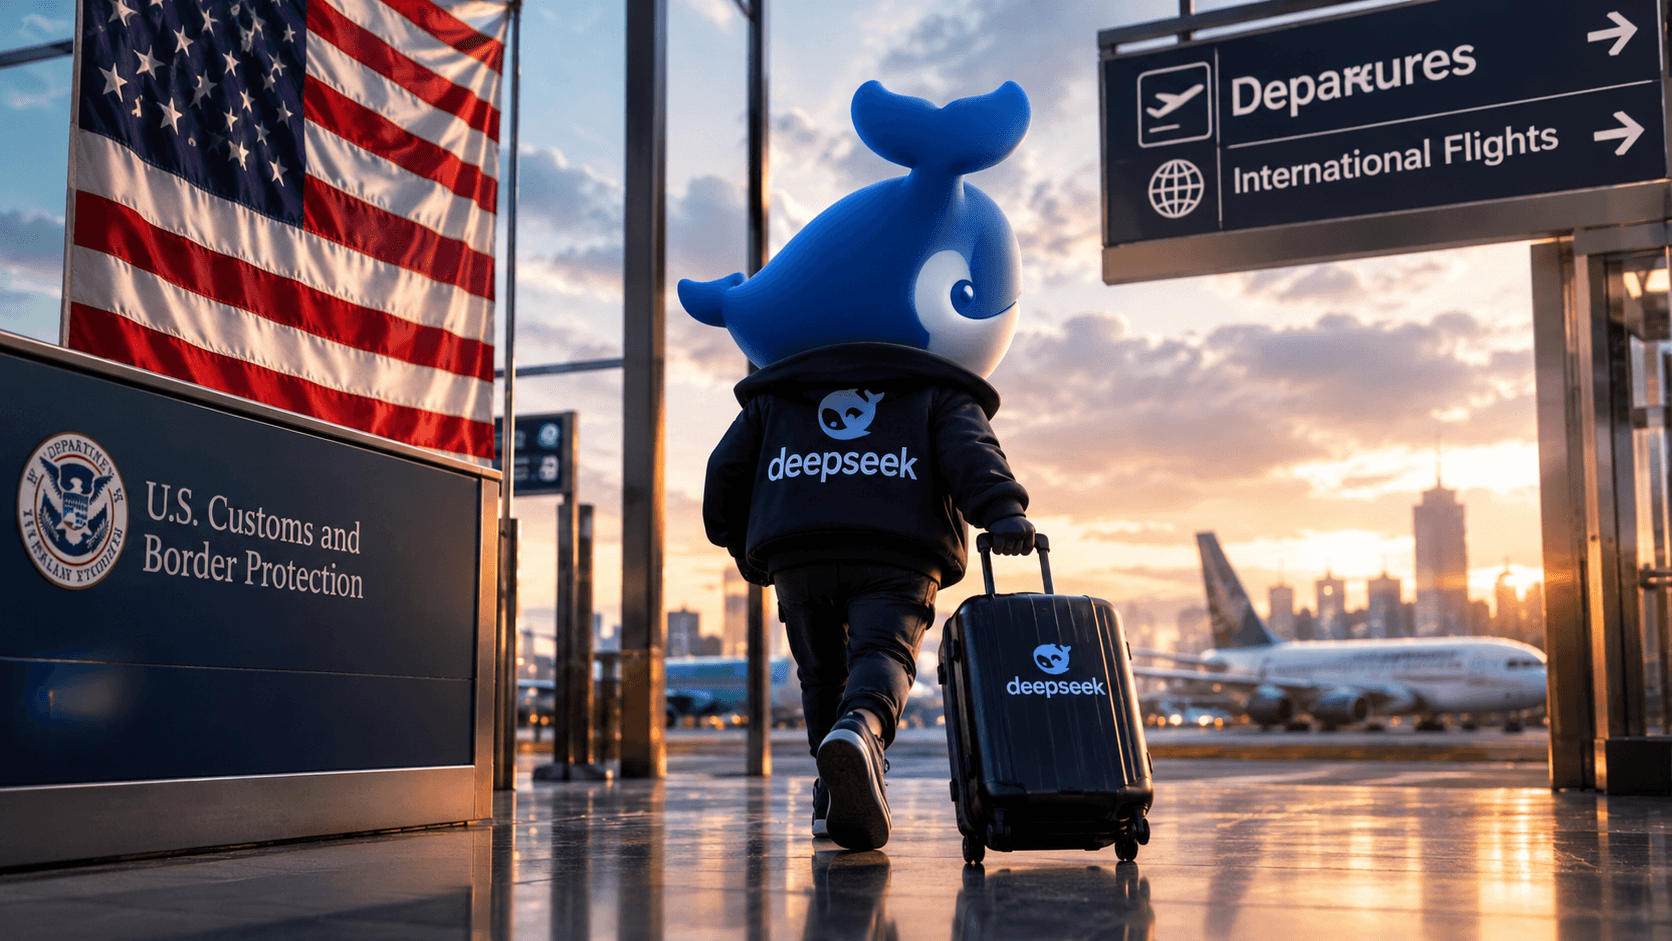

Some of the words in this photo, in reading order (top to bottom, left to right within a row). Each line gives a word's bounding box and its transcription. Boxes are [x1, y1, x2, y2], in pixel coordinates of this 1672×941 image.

[1233, 138, 1431, 194] International
[1444, 125, 1560, 167] Flights
[767, 446, 918, 483] deepseek
[145, 480, 198, 527] U.S.
[208, 494, 314, 547] Customs
[320, 521, 361, 555] and
[142, 533, 237, 583] Border
[244, 550, 364, 599] Protection
[1006, 675, 1107, 699] deepseek
